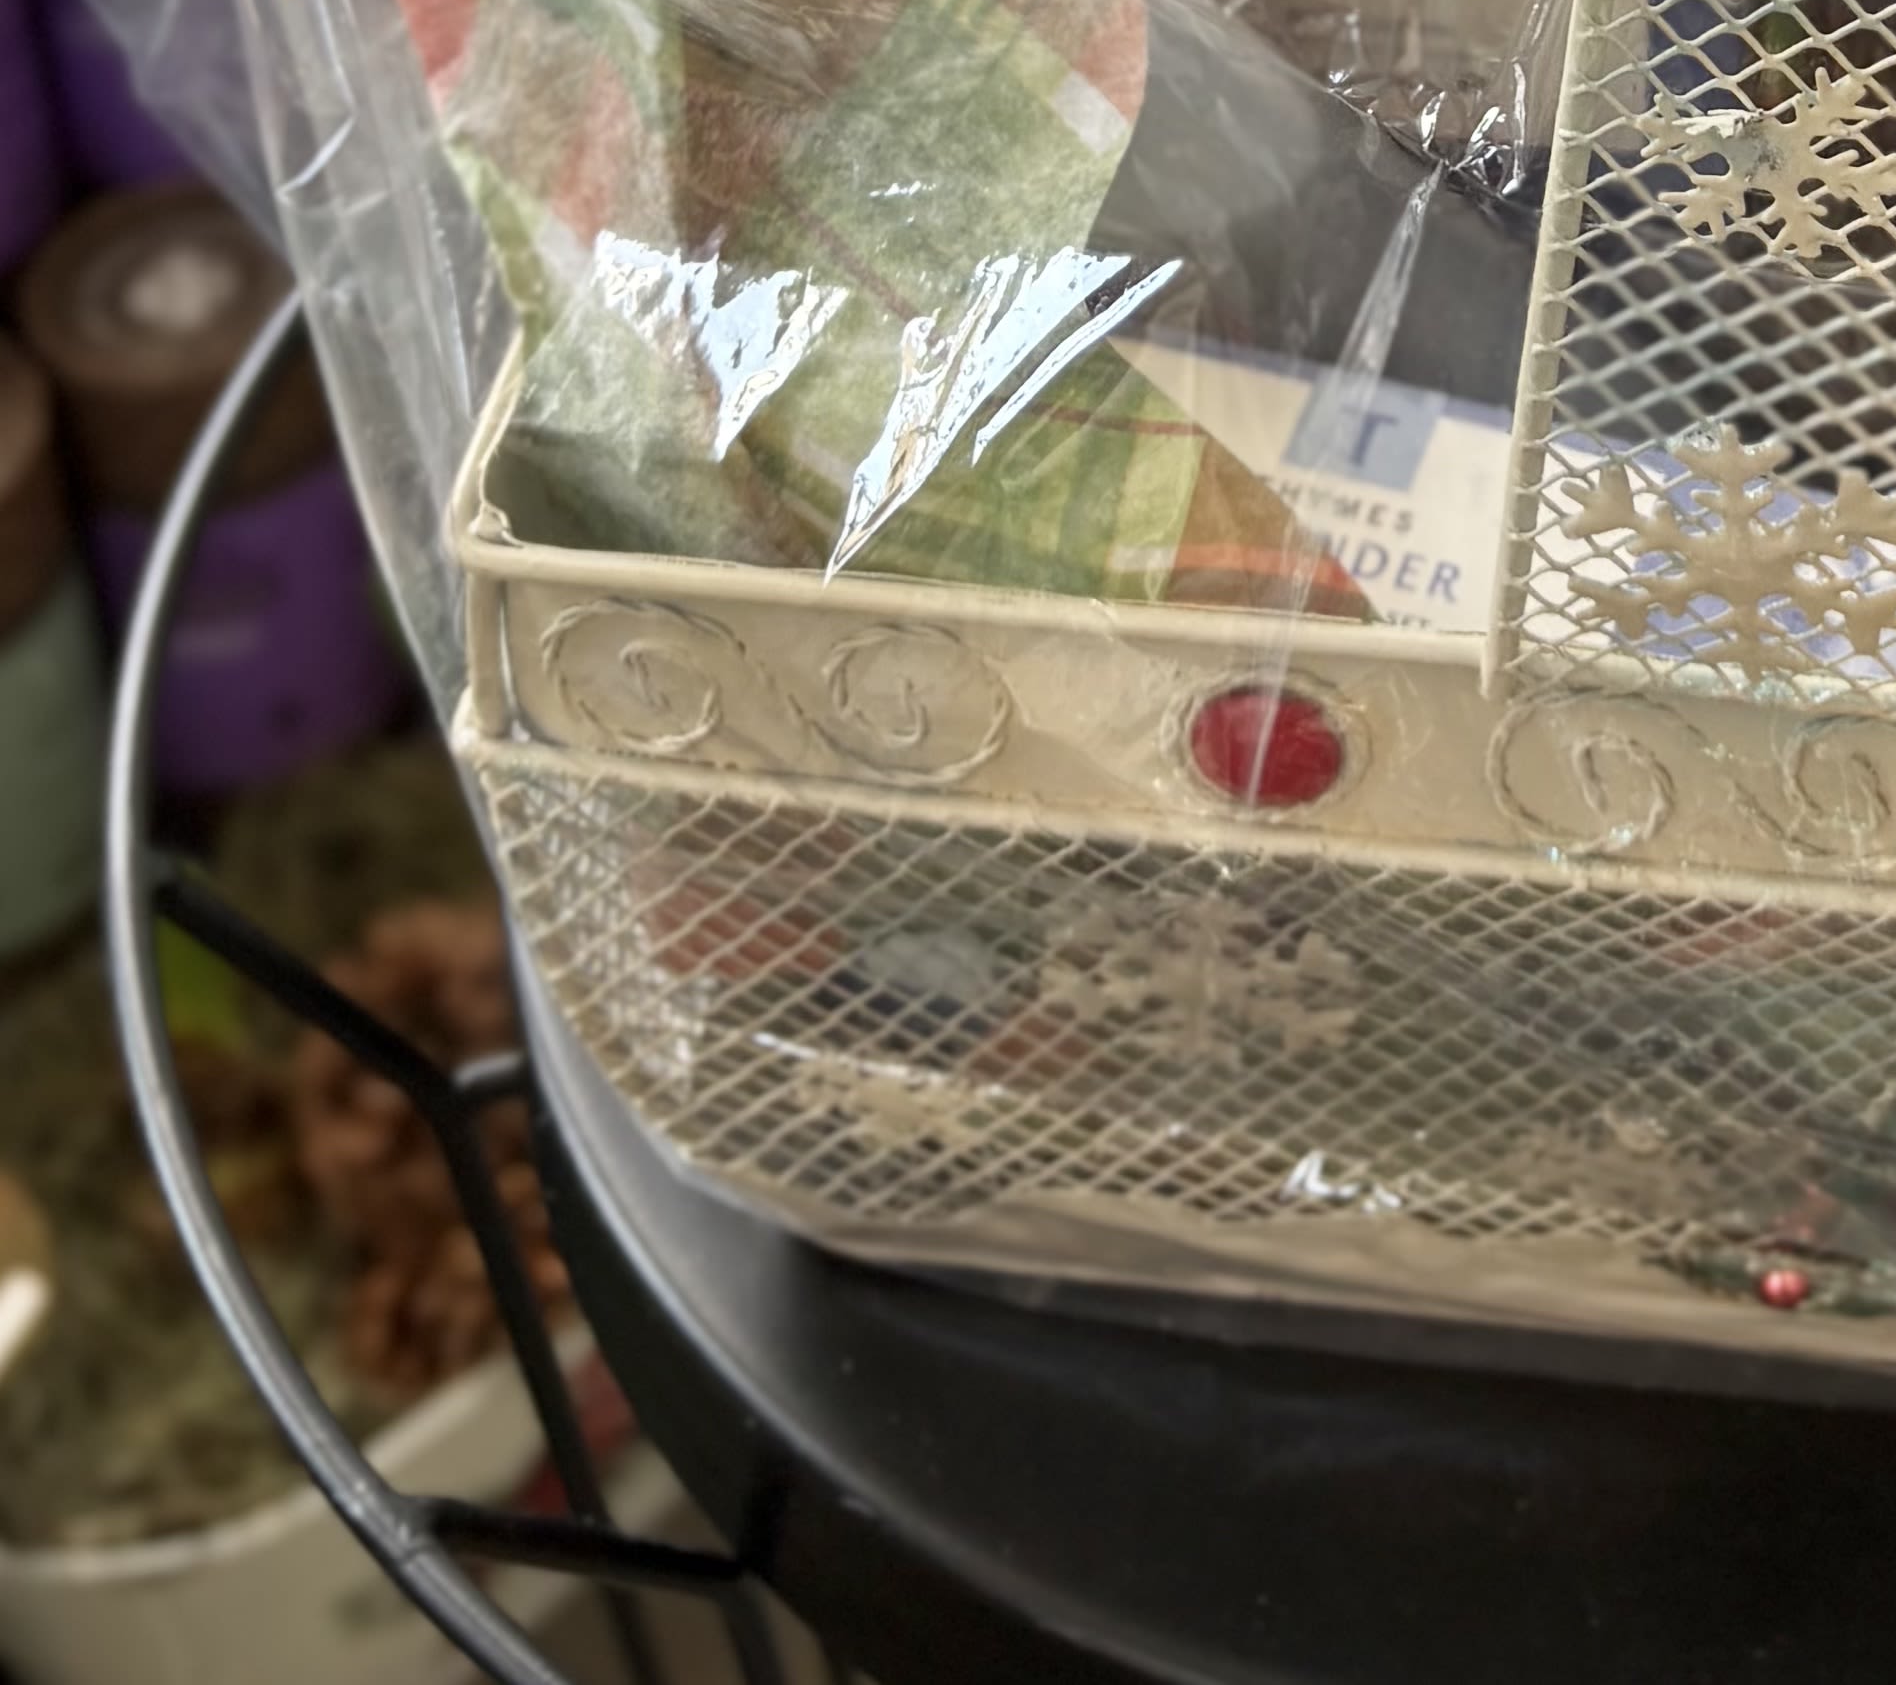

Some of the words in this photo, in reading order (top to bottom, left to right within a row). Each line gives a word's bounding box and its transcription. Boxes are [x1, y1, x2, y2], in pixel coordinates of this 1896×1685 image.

[1340, 406, 1399, 467] T
[1257, 476, 1414, 535] HYMES
[1315, 532, 1461, 604] NDER
